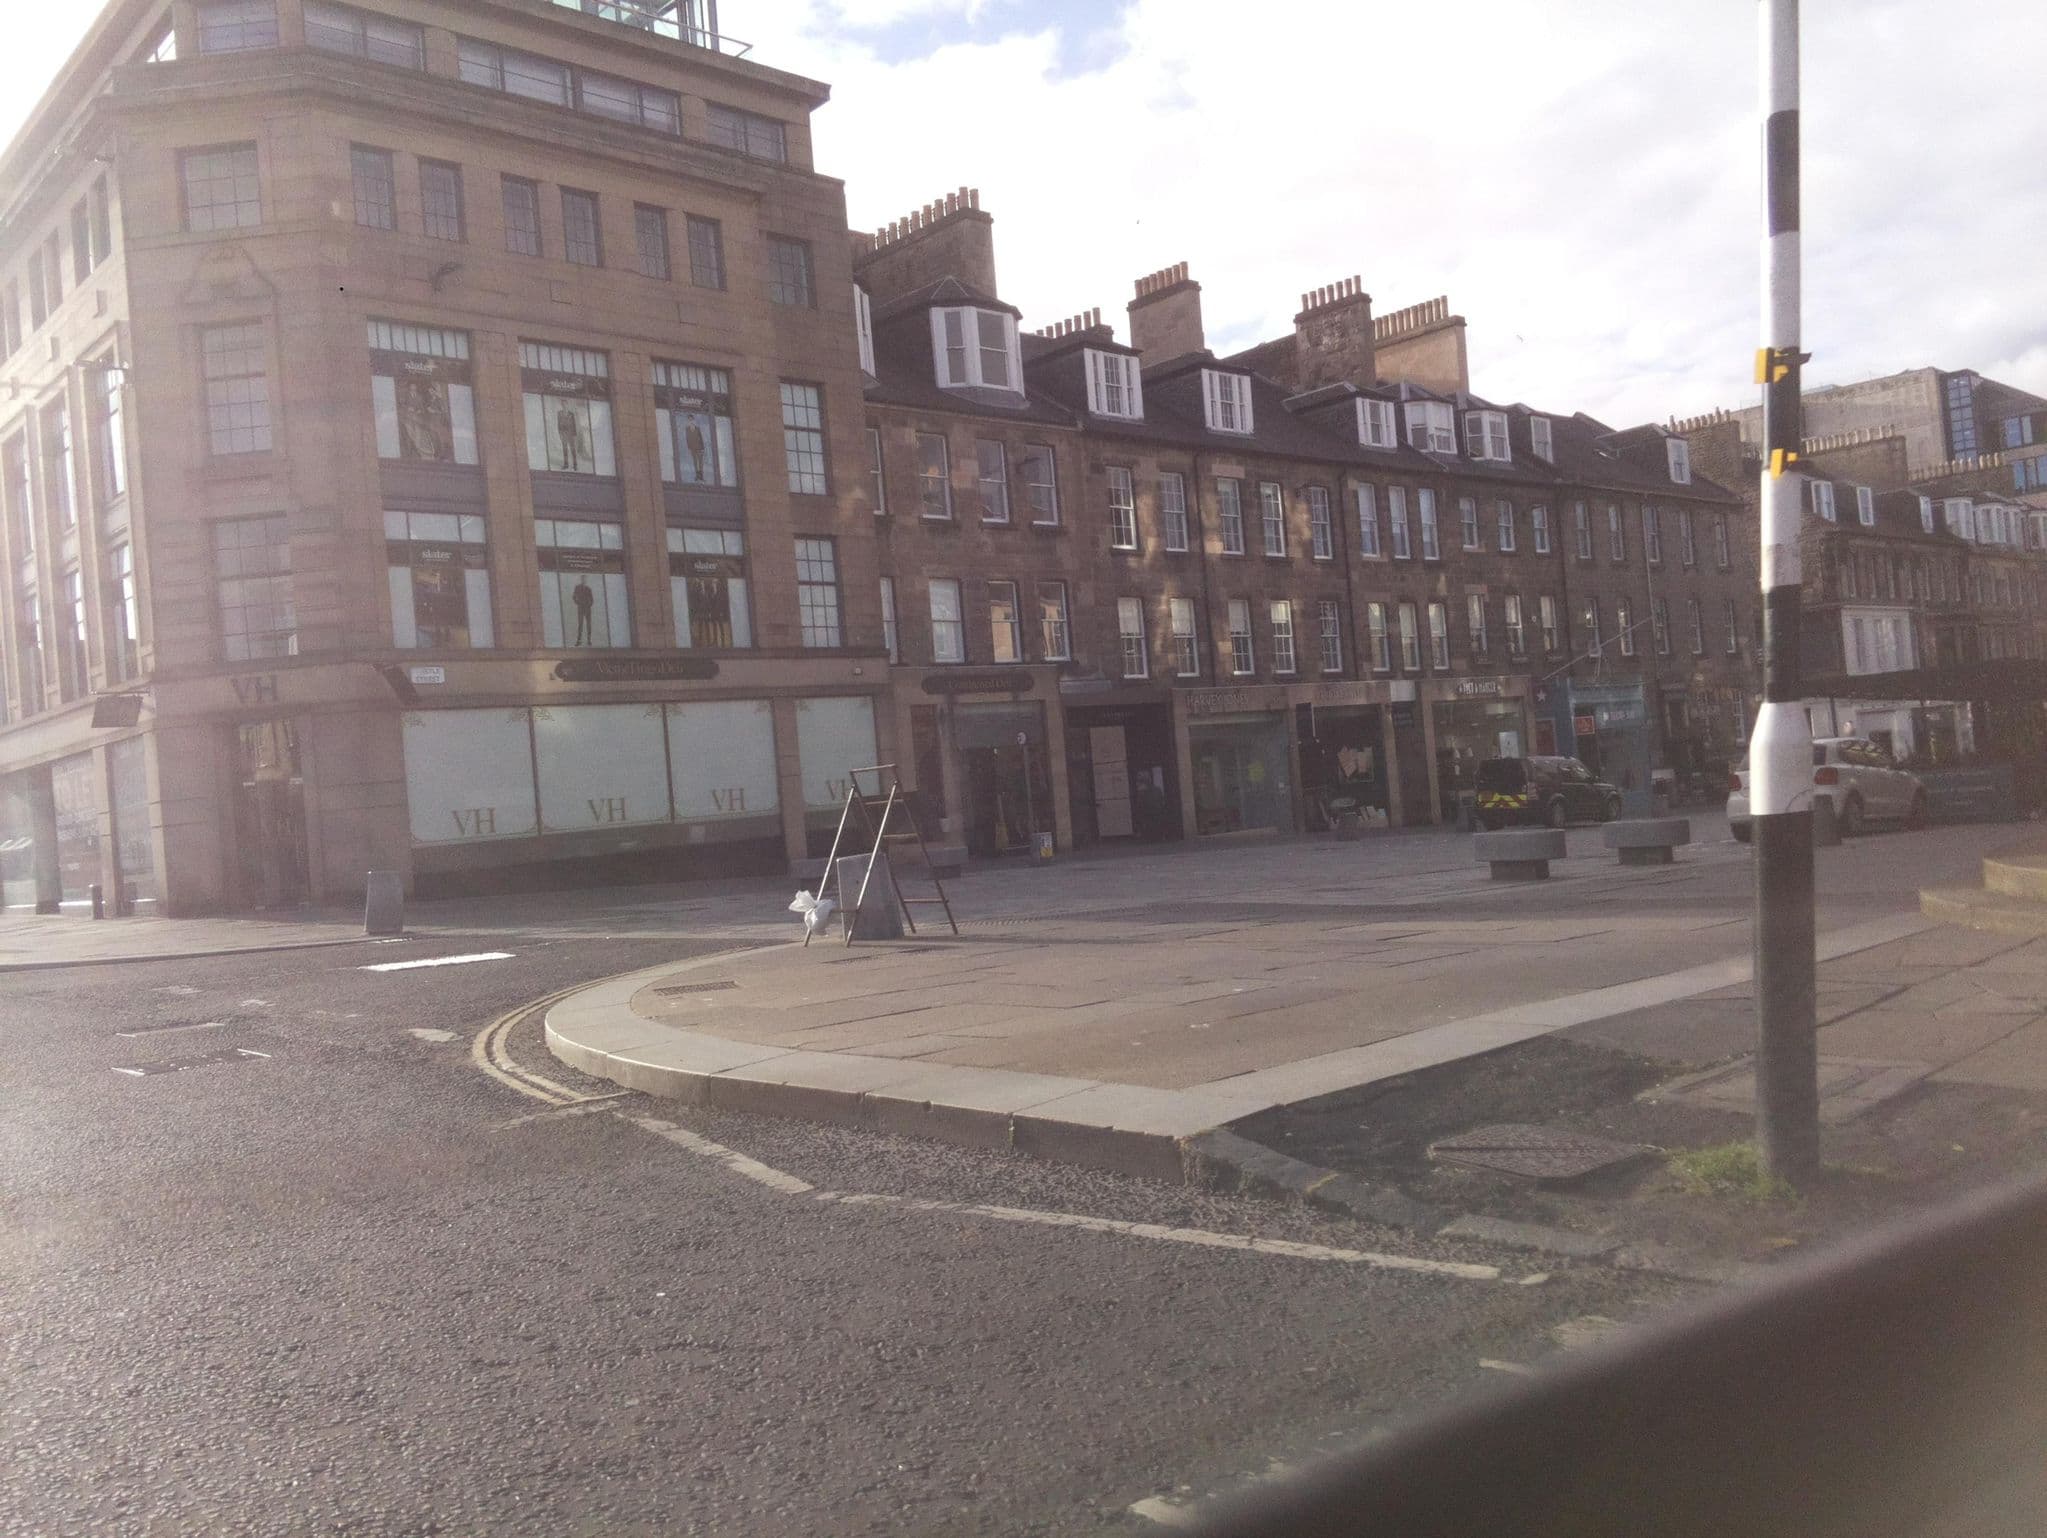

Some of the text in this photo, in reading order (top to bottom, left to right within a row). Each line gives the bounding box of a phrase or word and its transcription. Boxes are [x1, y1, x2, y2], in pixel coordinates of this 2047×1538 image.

[230, 675, 279, 704] VH
[586, 797, 627, 823] VH
[711, 787, 745, 812] VH
[451, 807, 497, 836] VH
